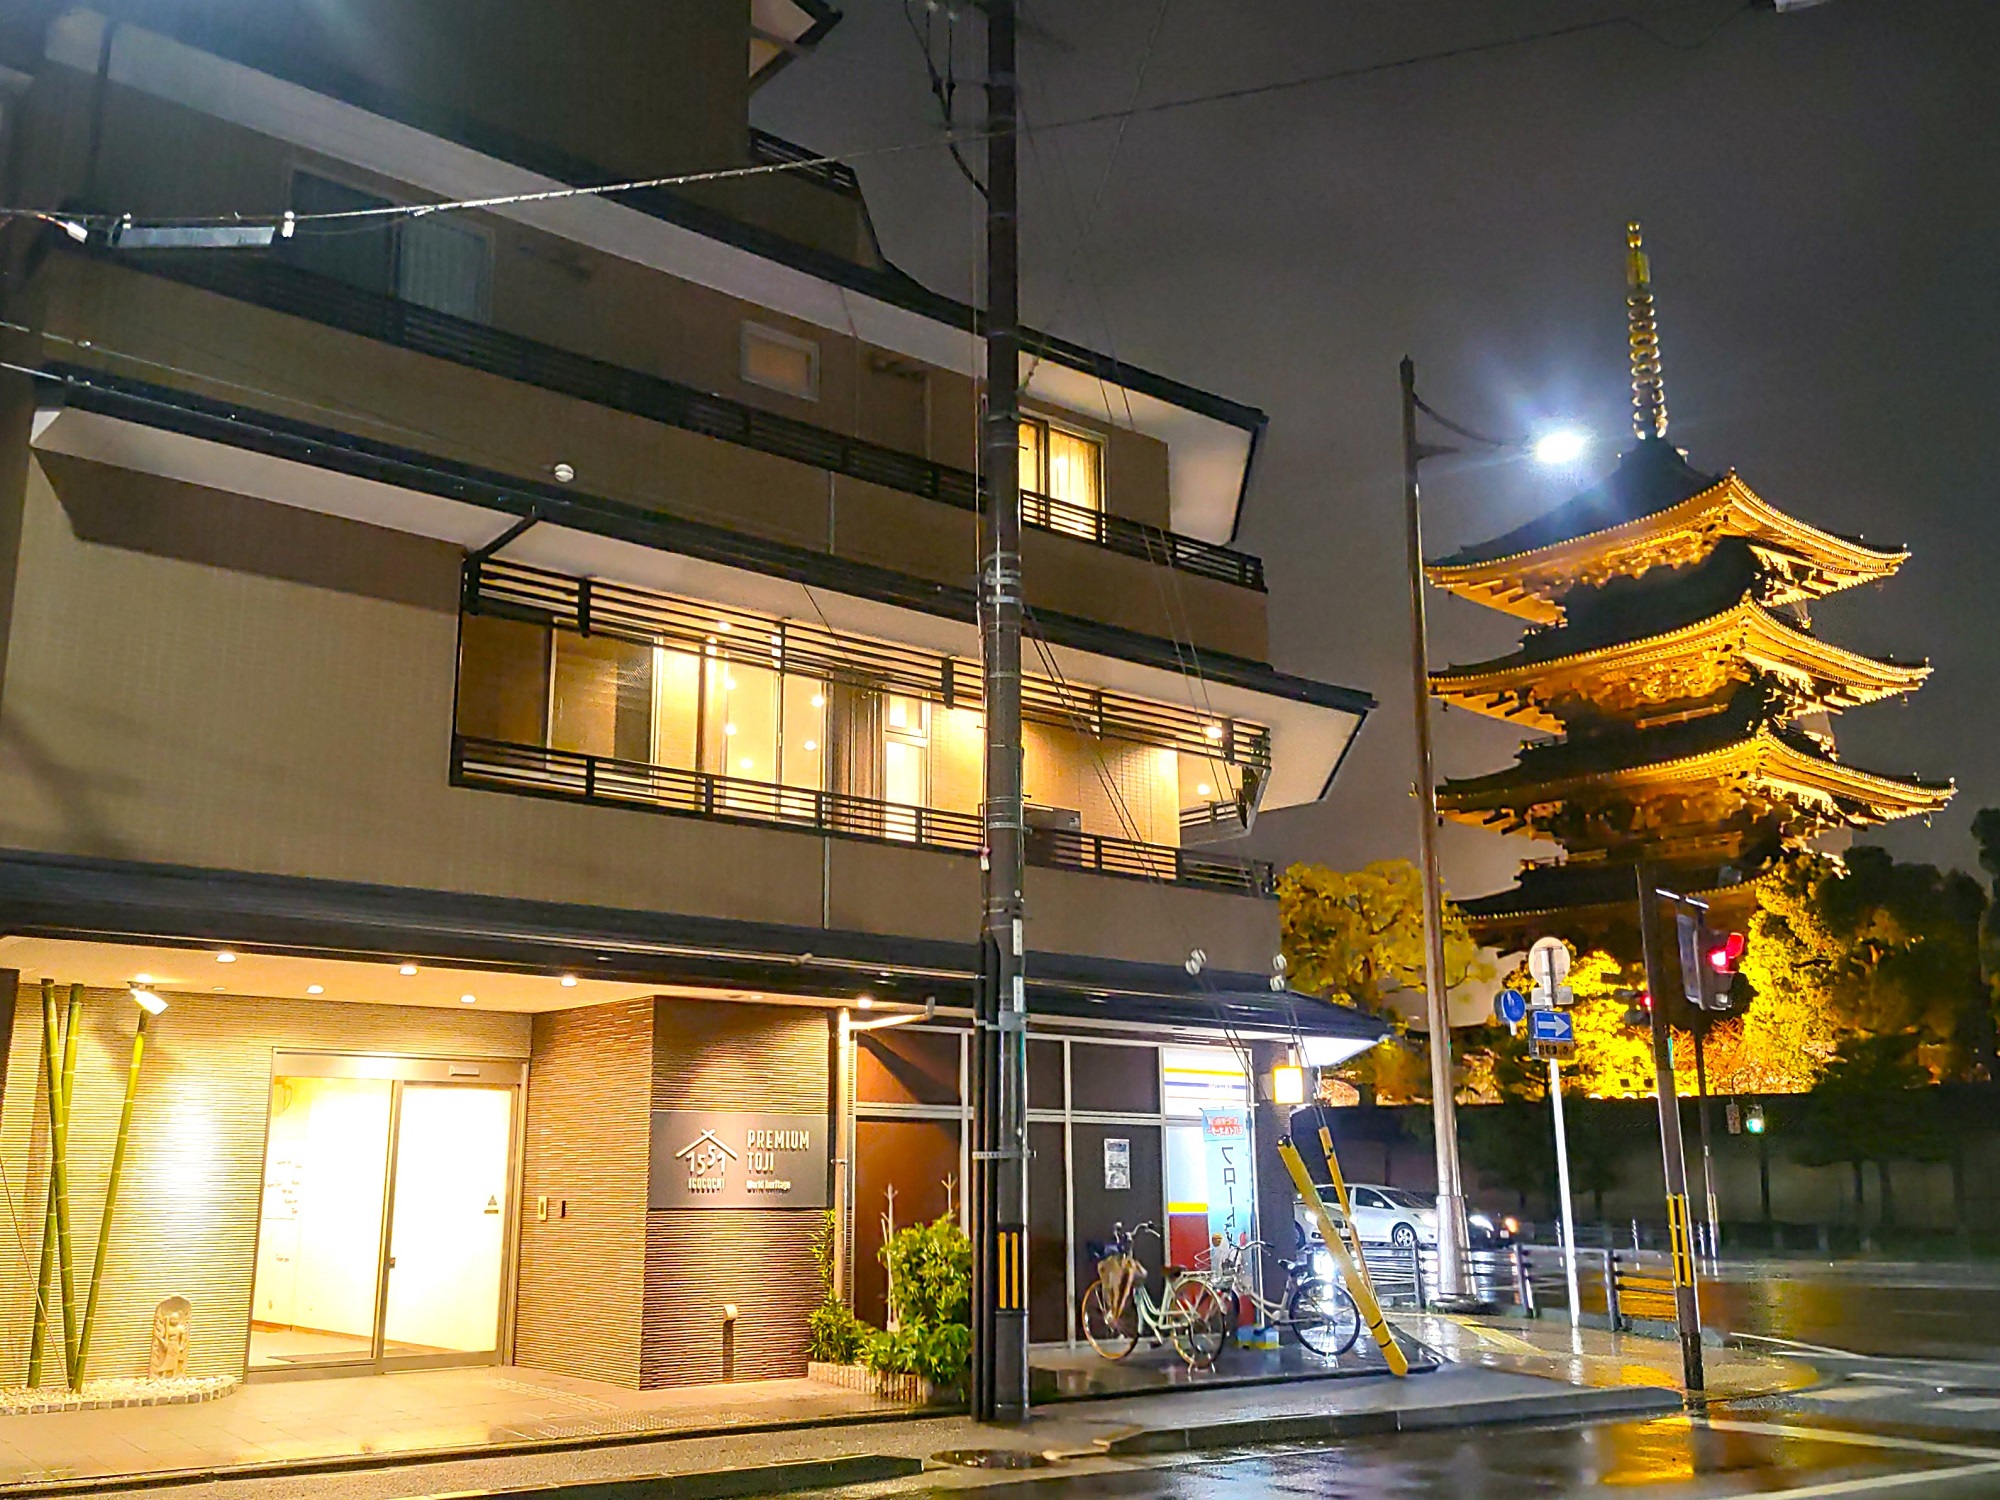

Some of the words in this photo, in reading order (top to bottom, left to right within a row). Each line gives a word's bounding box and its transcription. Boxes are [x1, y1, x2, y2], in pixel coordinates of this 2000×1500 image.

[747, 1129, 810, 1149] PREMIUM
[686, 1145, 726, 1175] 1551
[746, 1151, 774, 1171] TOJI
